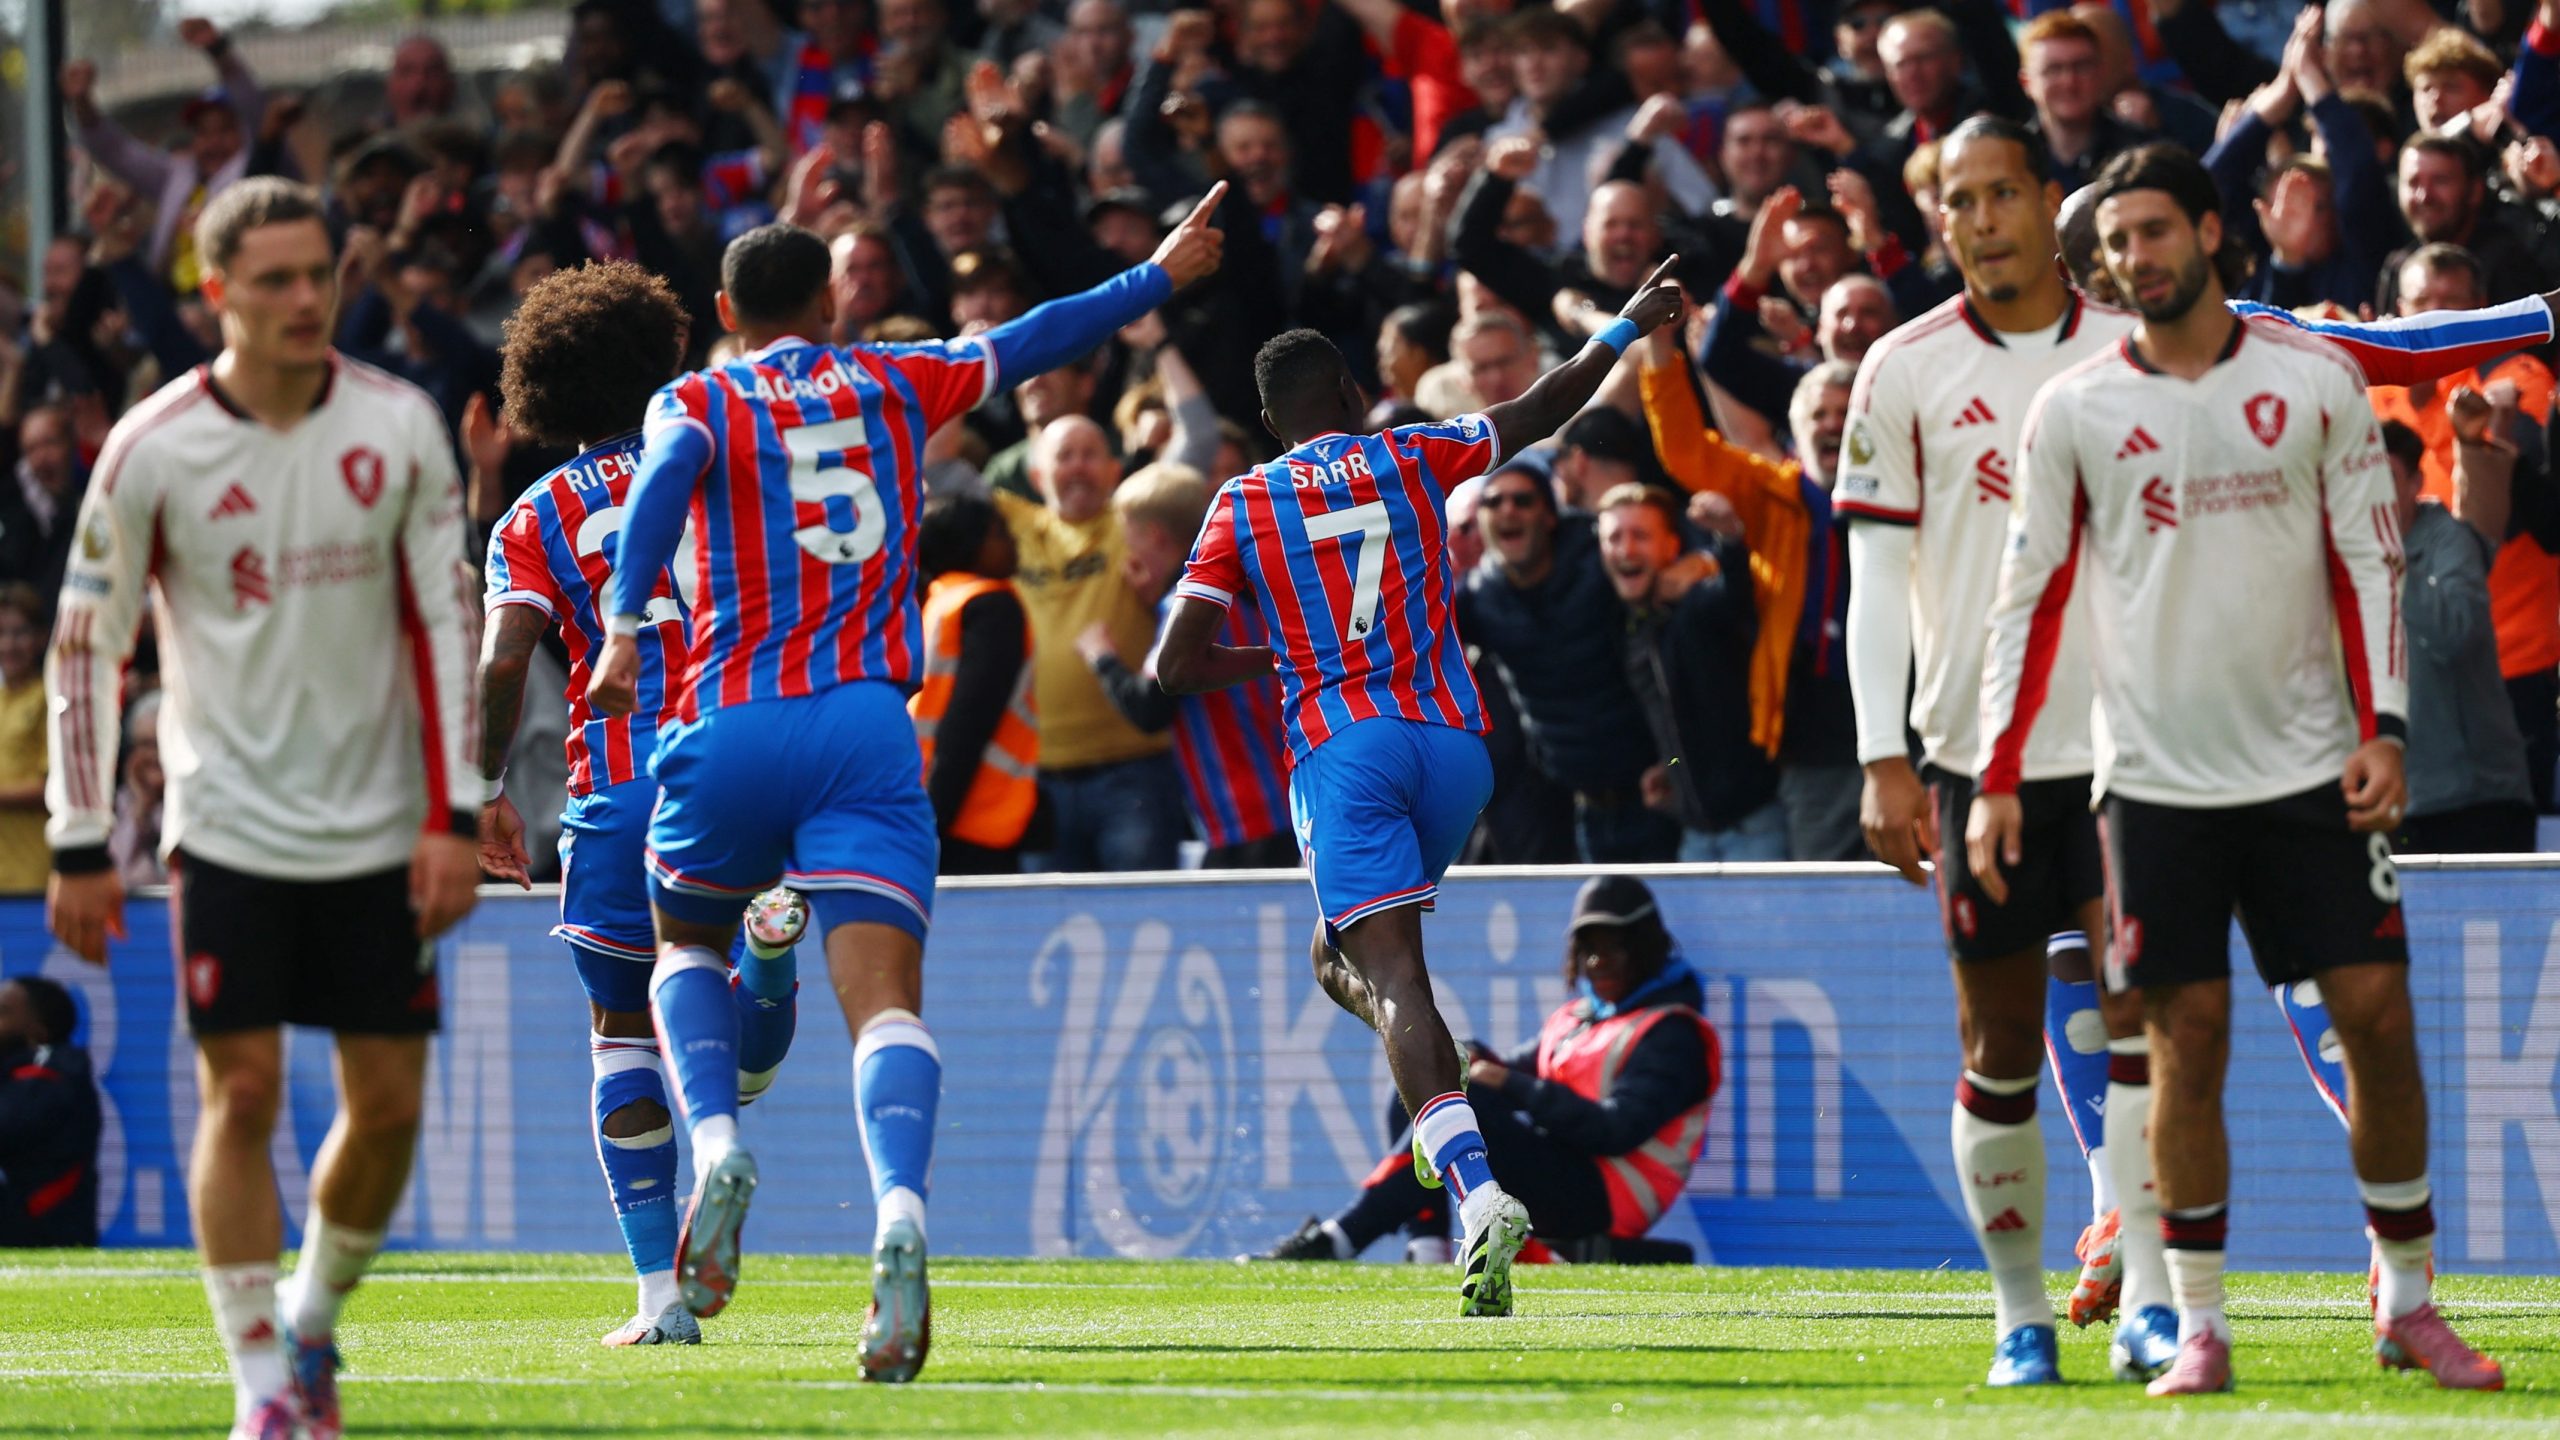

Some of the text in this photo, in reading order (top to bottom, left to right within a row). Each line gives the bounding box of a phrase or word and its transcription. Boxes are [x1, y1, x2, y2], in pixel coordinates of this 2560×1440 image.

[562, 449, 649, 493] RICH
[783, 415, 887, 564] 5
[1290, 452, 1372, 489] SARR
[576, 505, 698, 634] 2
[1303, 500, 1391, 642] 7
[2366, 830, 2400, 903] 8
